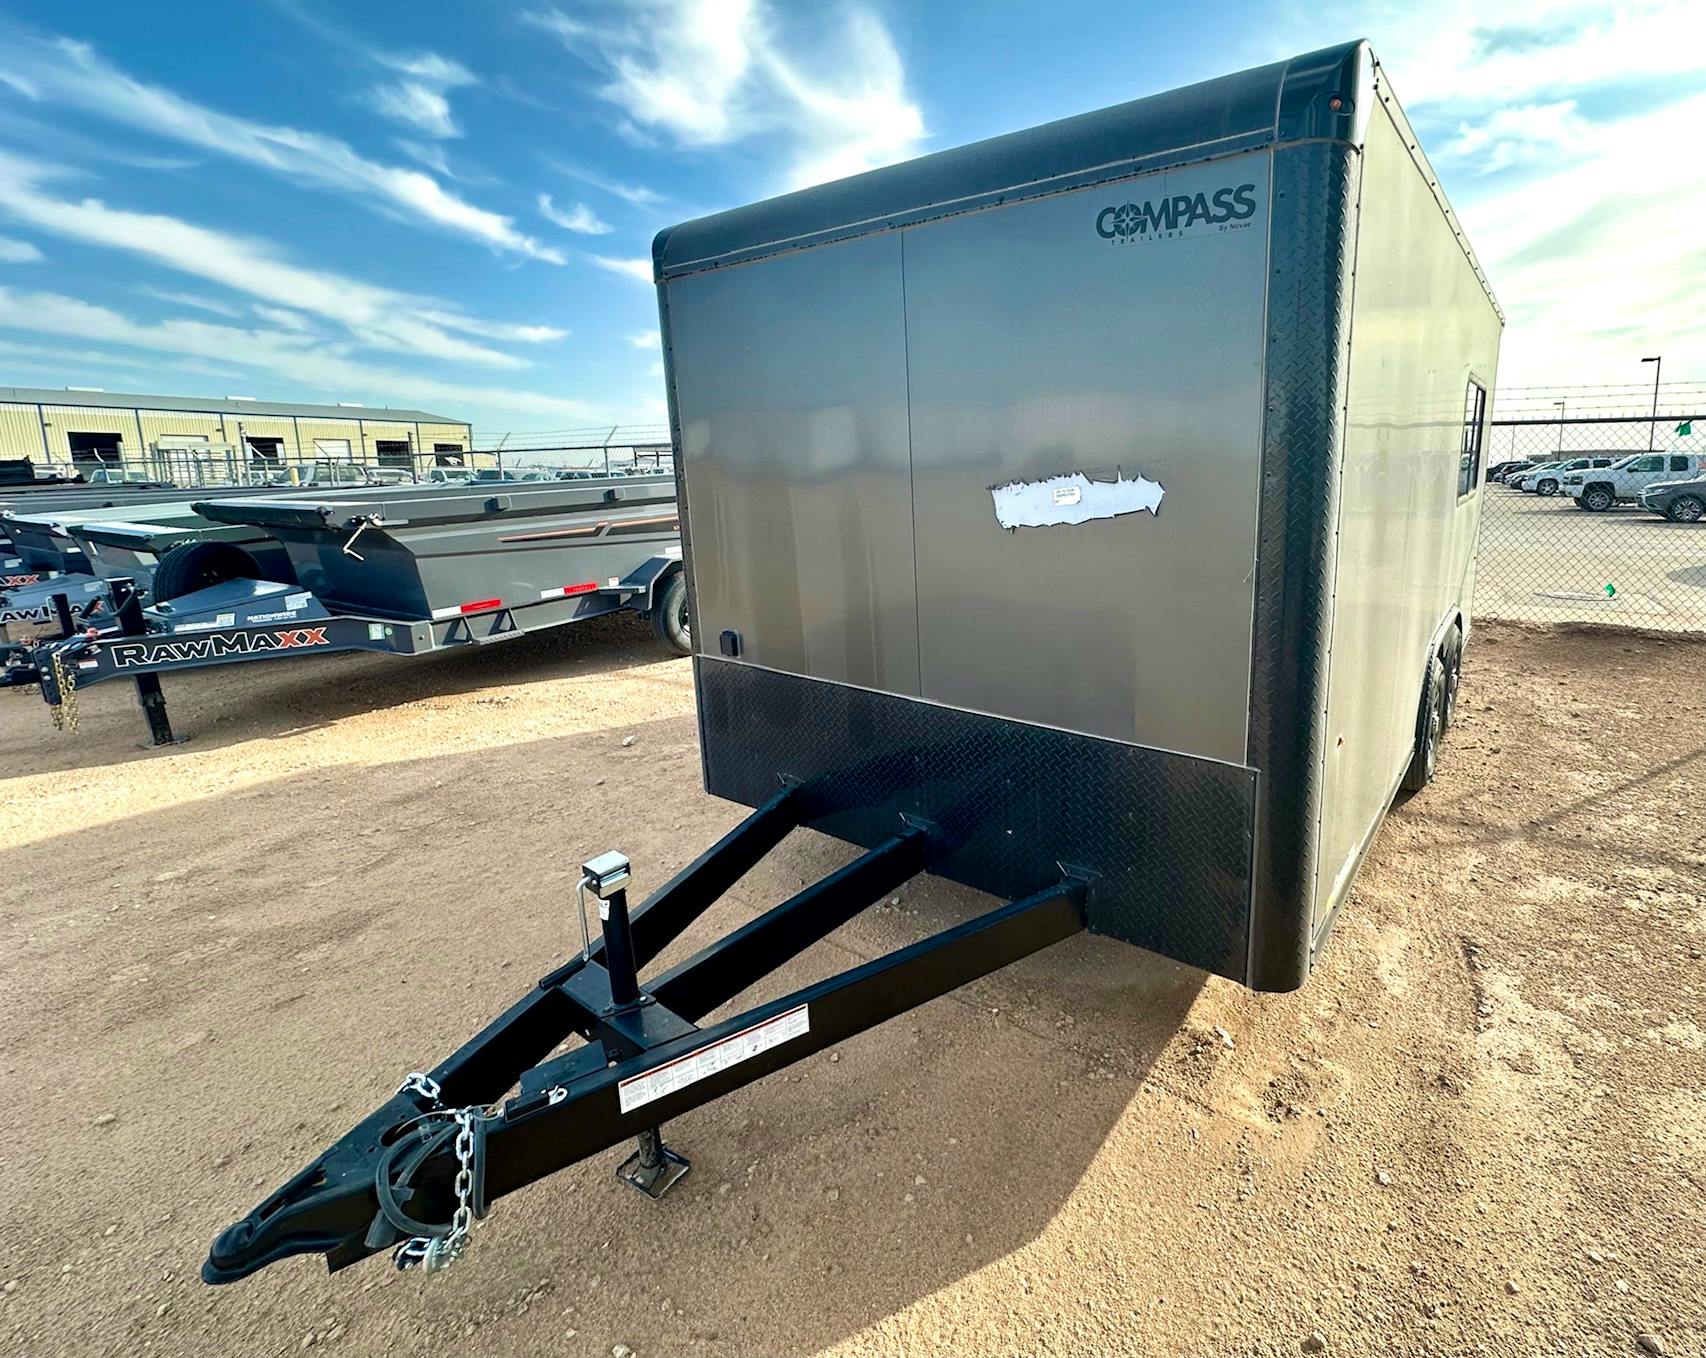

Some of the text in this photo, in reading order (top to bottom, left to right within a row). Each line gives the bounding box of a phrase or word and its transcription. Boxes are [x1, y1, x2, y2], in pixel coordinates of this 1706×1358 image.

[1096, 184, 1256, 239] COMPASS
[1111, 230, 1184, 246] TRAILERS
[246, 611, 297, 621] NATIONWIDE
